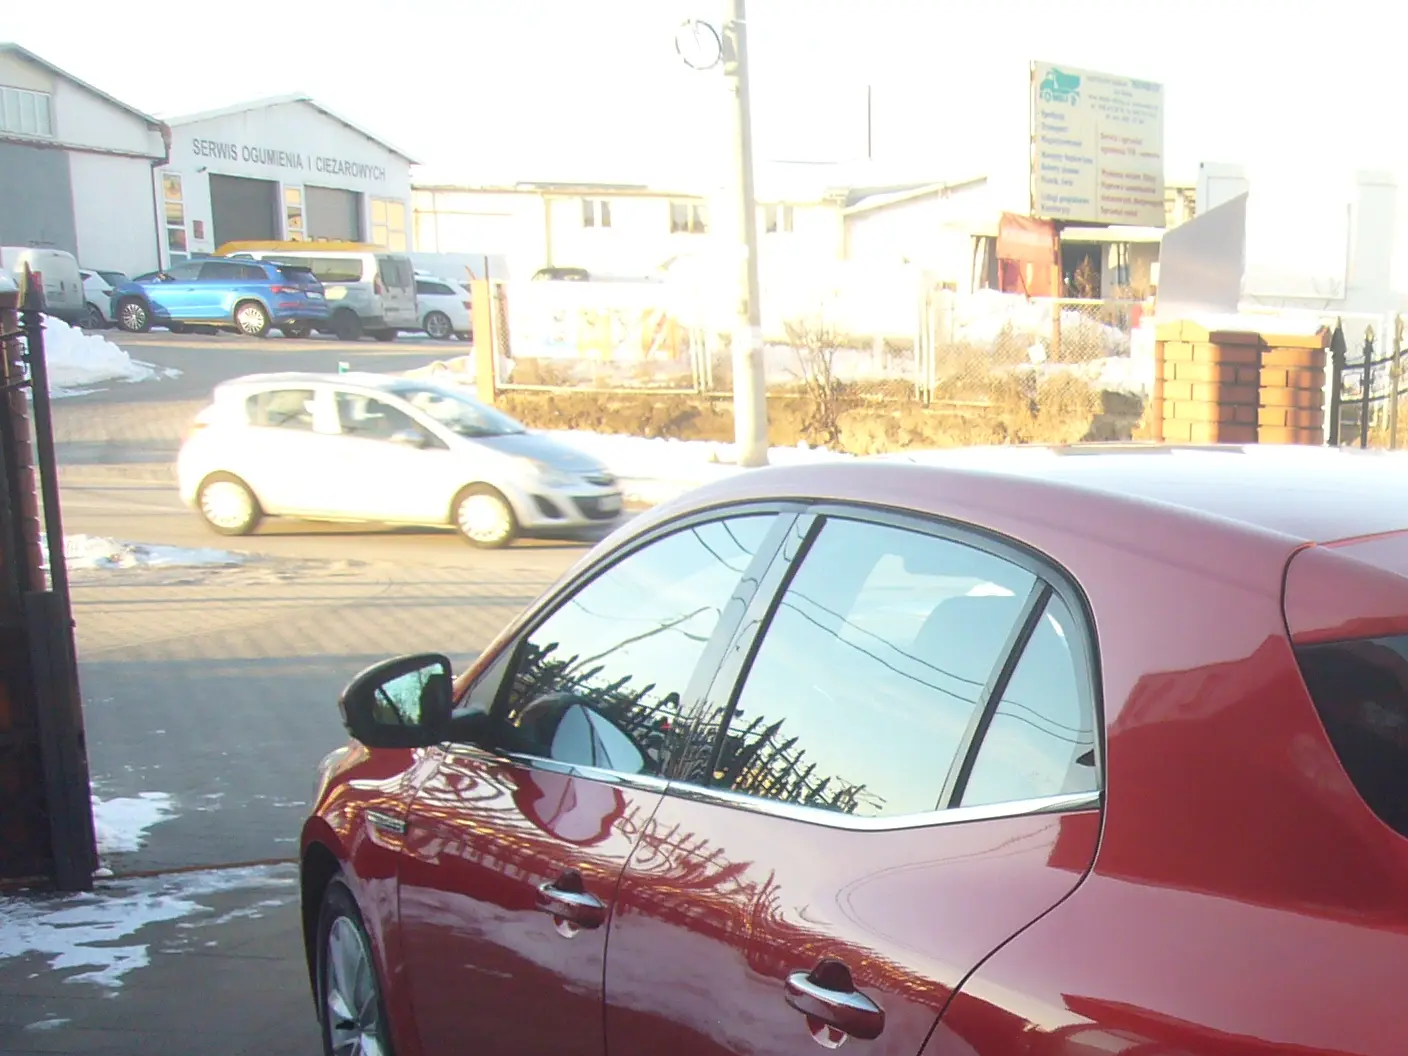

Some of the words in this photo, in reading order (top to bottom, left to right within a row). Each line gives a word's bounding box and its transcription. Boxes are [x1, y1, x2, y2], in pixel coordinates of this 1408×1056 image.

[192, 138, 238, 162] SERWIS
[241, 144, 304, 170] OGUMIENIA
[307, 155, 312, 171] I
